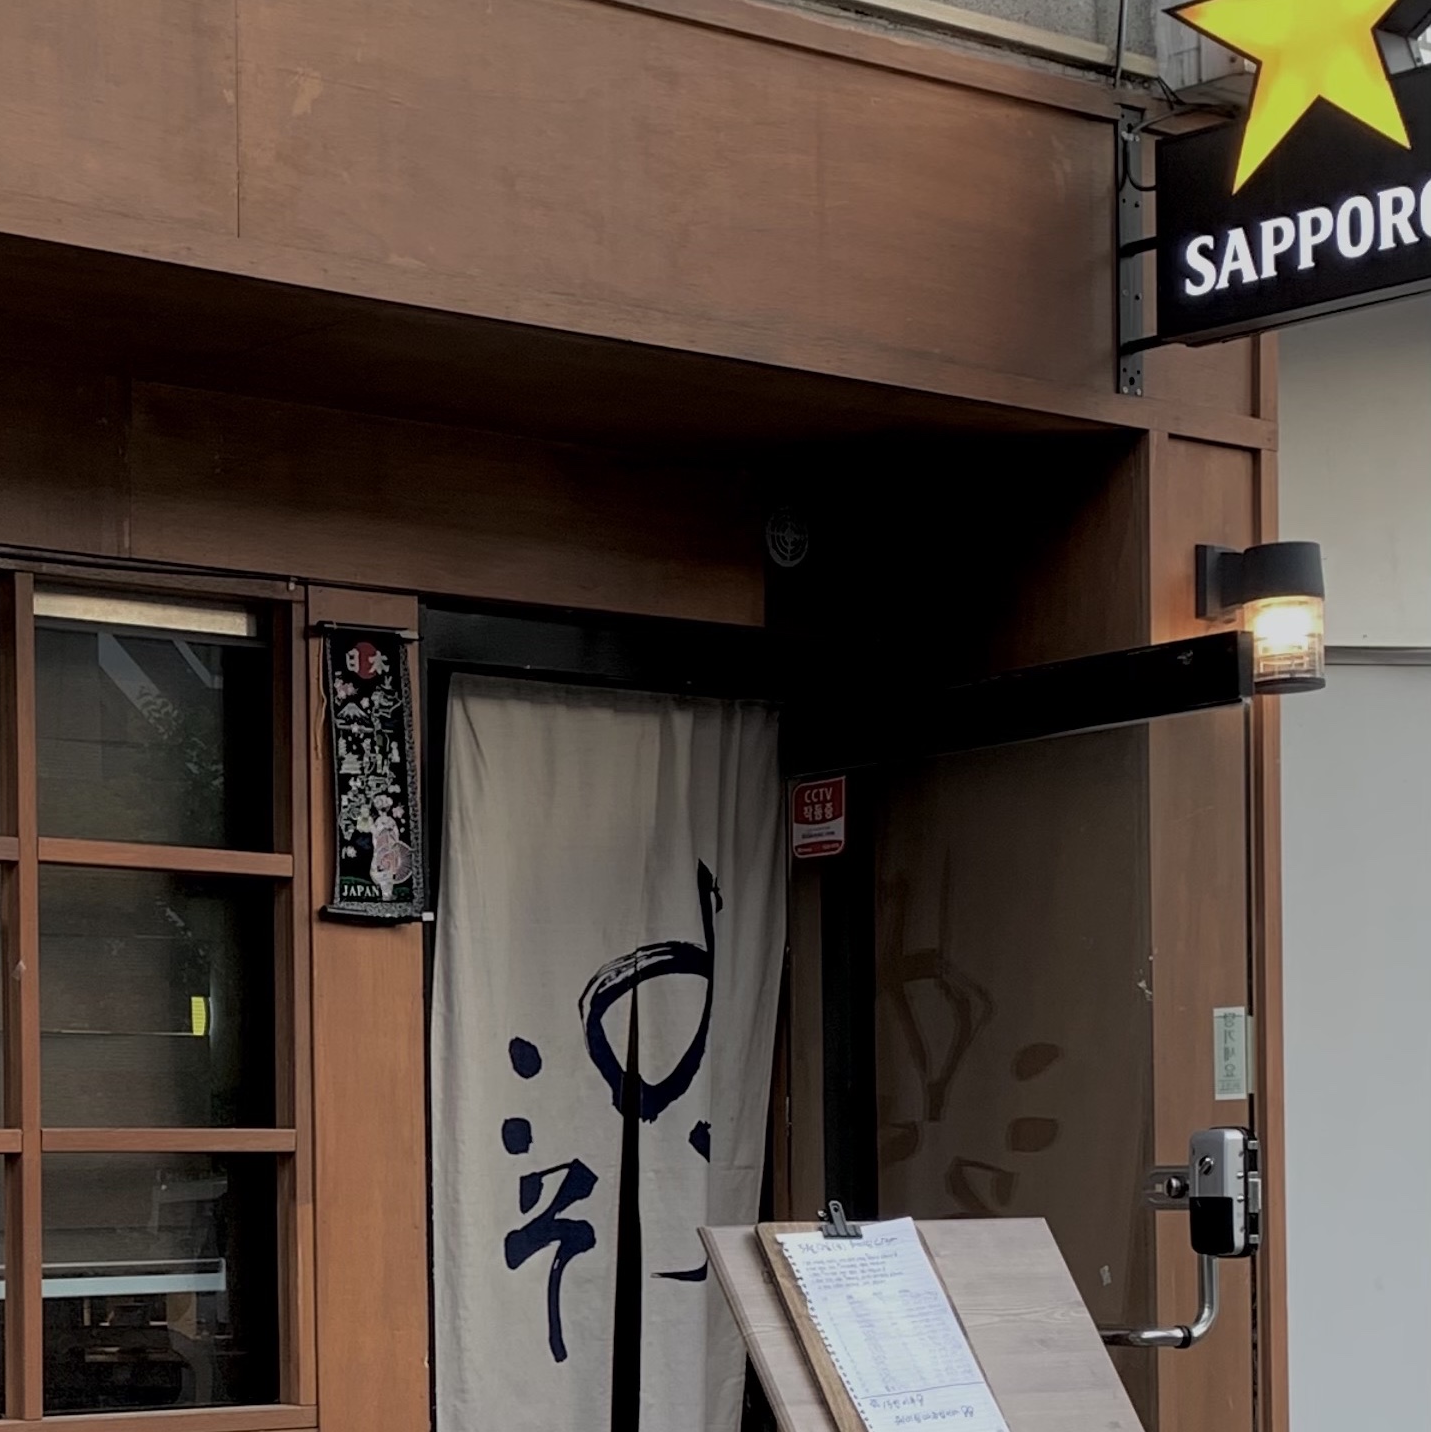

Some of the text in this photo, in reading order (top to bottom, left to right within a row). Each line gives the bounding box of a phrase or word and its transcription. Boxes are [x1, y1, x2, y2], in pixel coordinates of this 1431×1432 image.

[345, 648, 390, 675] 日本
[804, 787, 833, 803] CCTV
[342, 884, 380, 897] JAPAN
